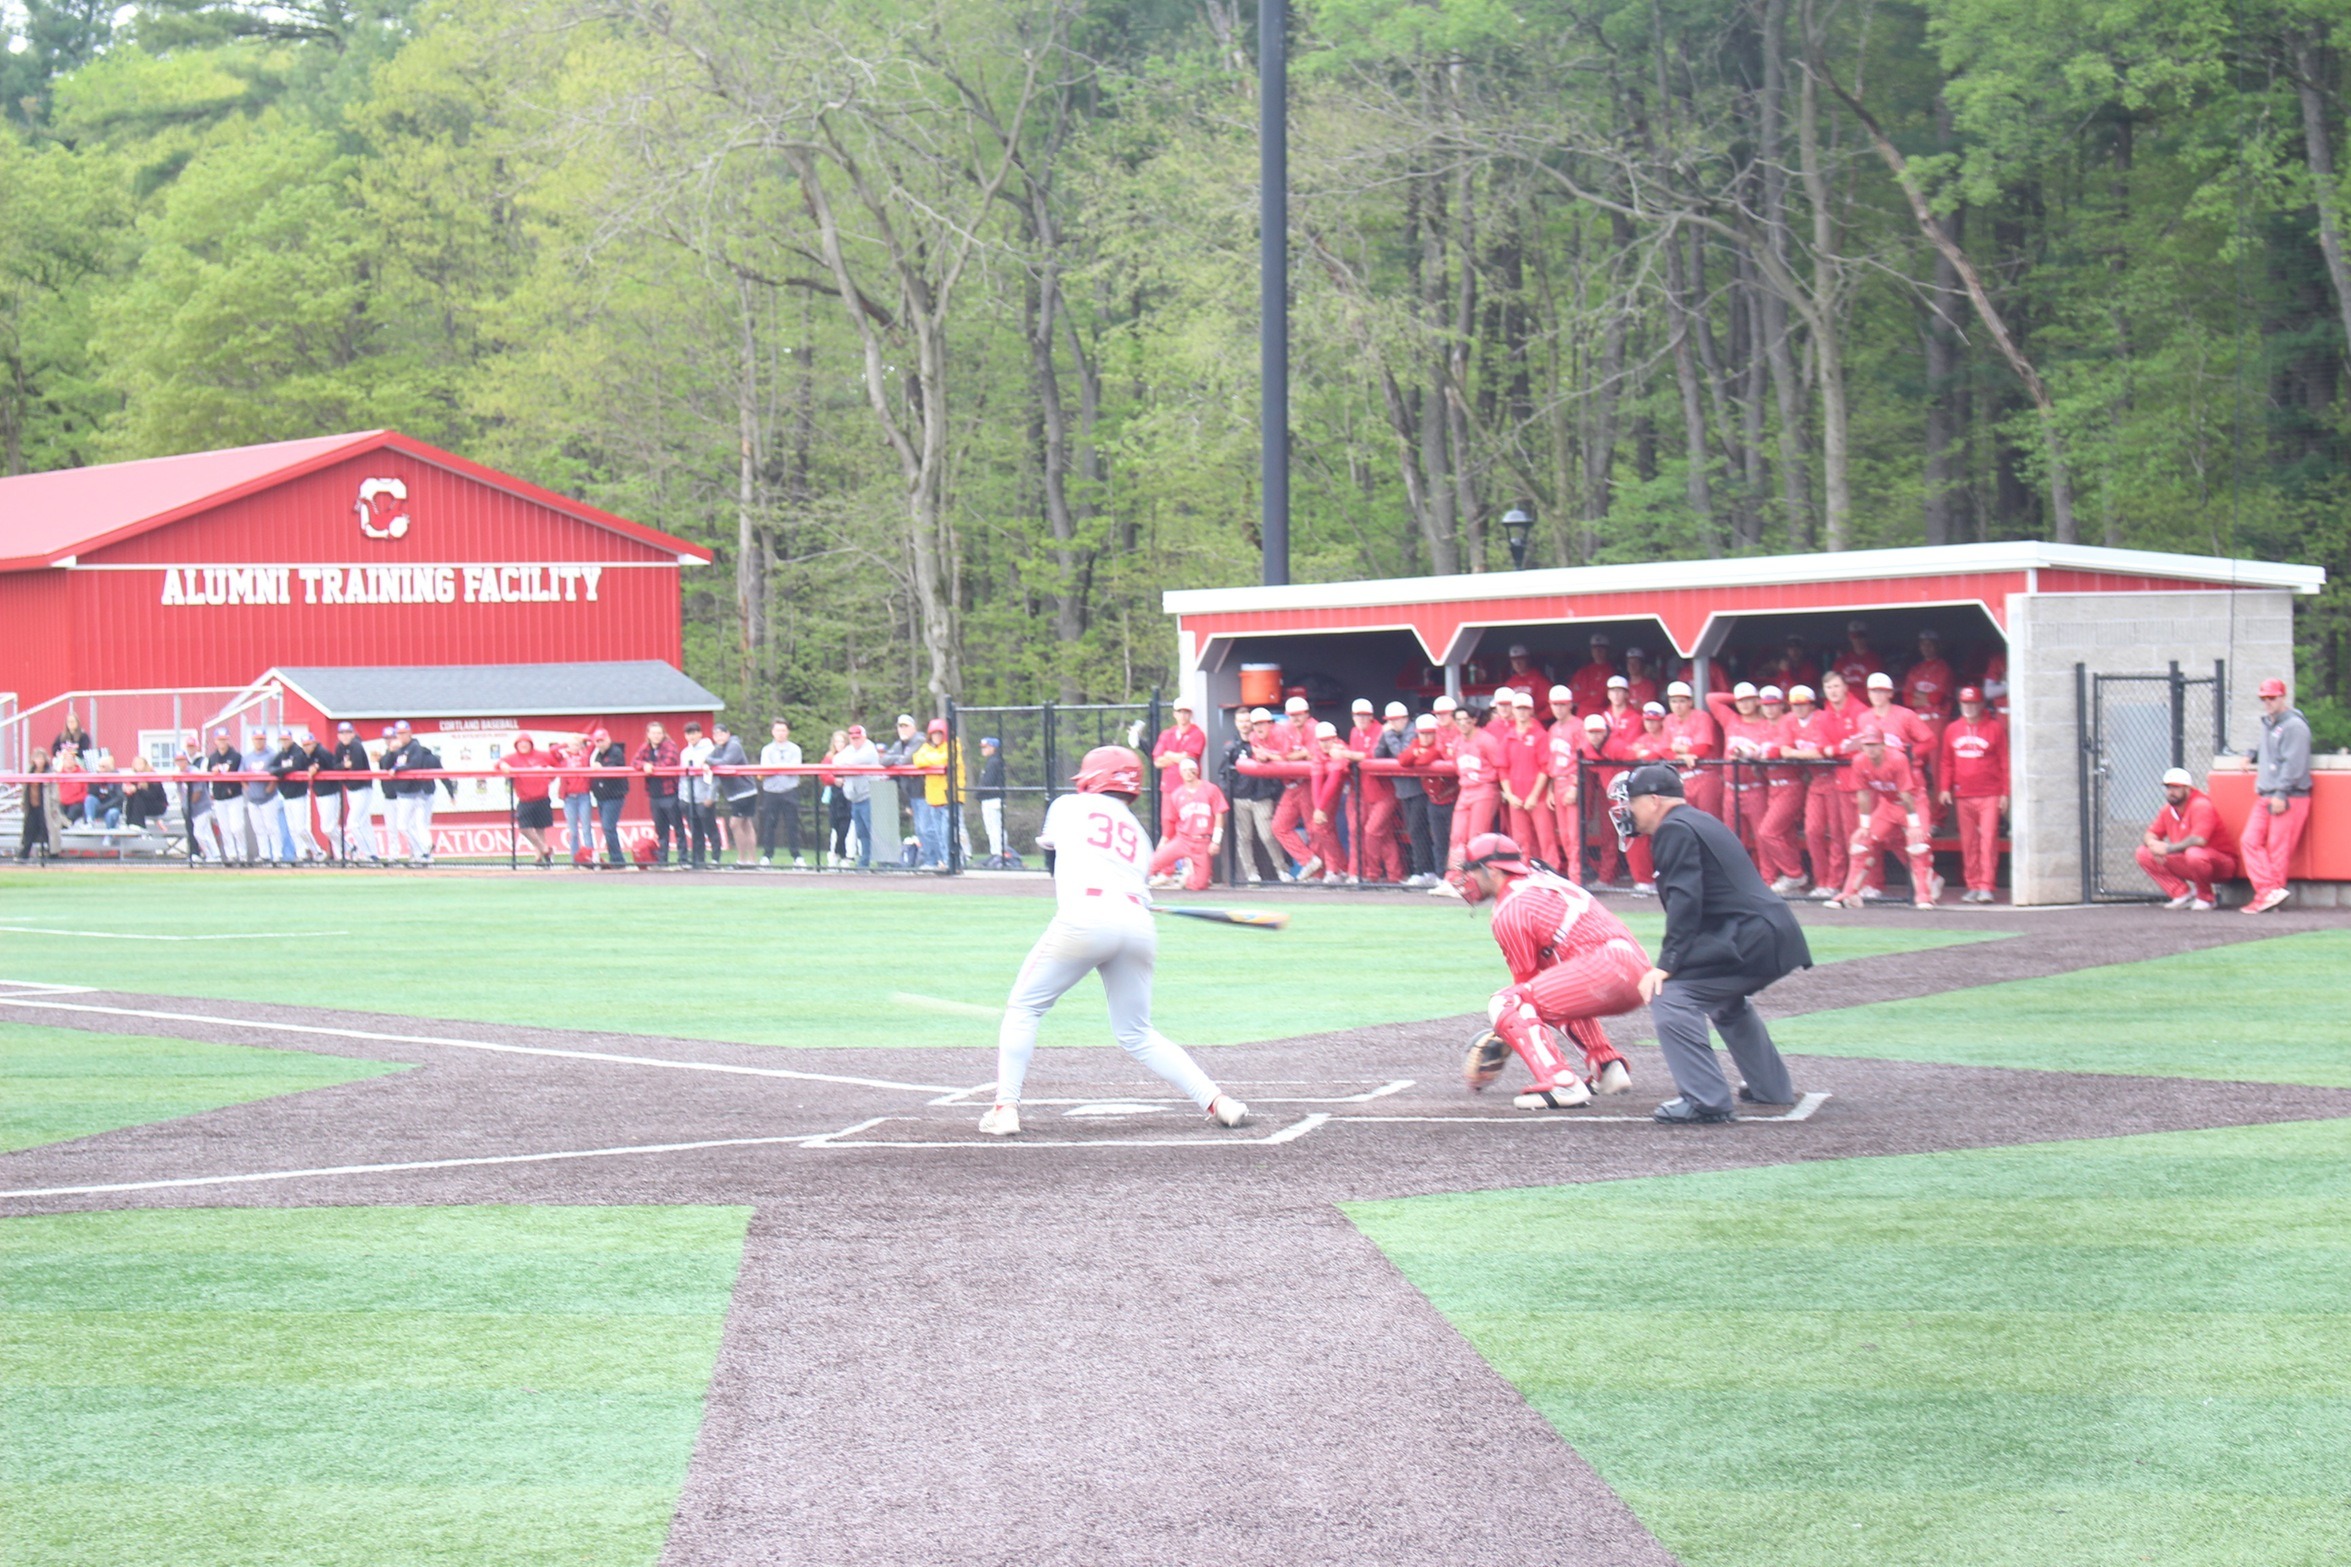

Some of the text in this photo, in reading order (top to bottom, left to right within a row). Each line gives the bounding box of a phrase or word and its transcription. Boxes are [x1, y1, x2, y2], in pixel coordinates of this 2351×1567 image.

[161, 566, 602, 606] ALUMNI TRAINING FACILITY
[424, 829, 555, 853] ATIONA
[1087, 812, 1137, 863] 39
